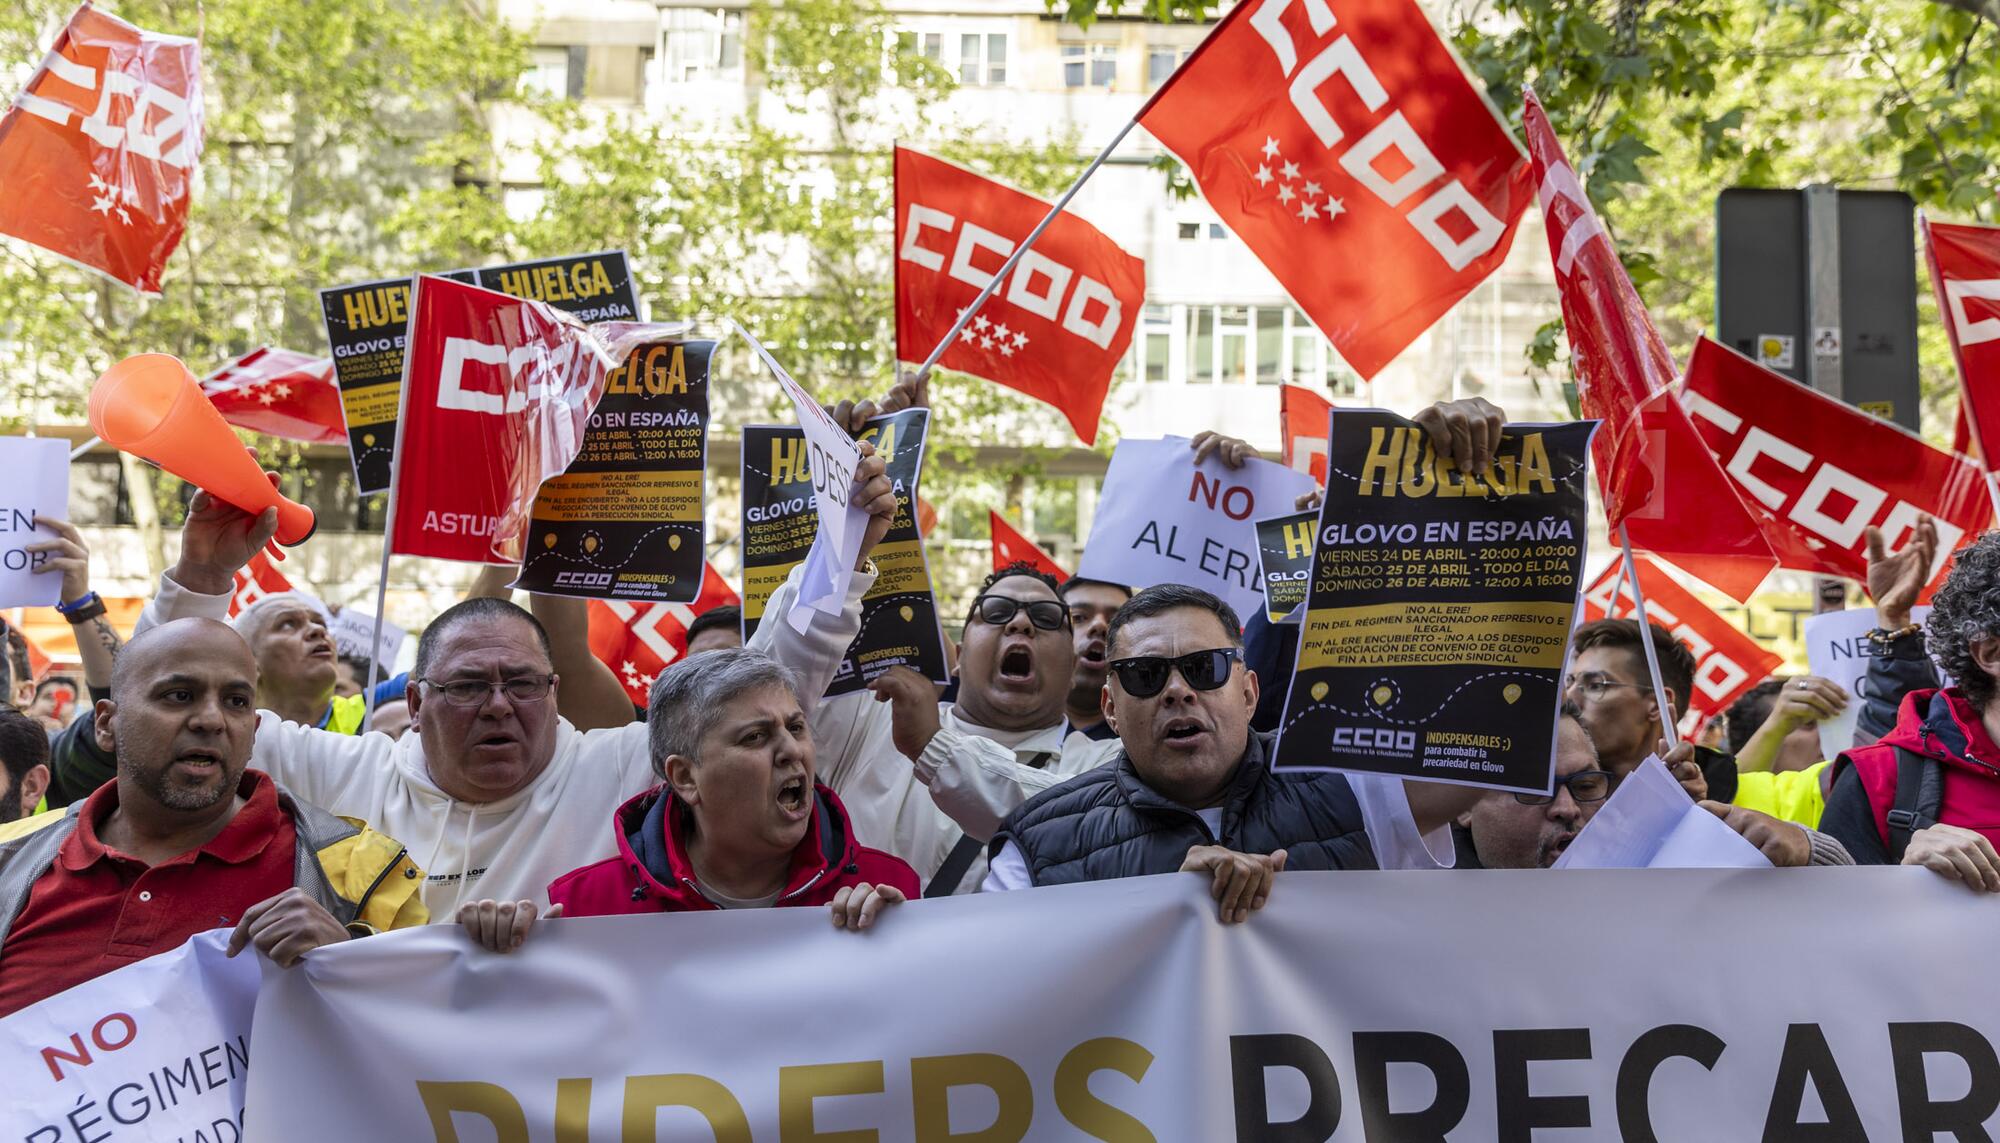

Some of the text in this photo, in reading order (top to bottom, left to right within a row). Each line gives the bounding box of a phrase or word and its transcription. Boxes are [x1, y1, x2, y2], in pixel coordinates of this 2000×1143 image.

[1249, 0, 1506, 272] CCOO
[500, 260, 613, 302] HUELGA
[900, 202, 1122, 351] CCOO
[335, 338, 391, 357] GLOVO
[604, 346, 687, 395] ELGA
[605, 412, 626, 428] EN
[630, 409, 700, 426] ESPAÑA
[596, 432, 608, 441] DE
[609, 431, 631, 440] ABRIL
[638, 430, 663, 438] 20:00
[675, 429, 701, 437] 00:00
[588, 438, 698, 451] 25 DE ABRIL TODO EL DÍA
[590, 449, 700, 461] 26 DE ABRIL 12:00 A 16:00
[601, 481, 651, 489] SANCIONADOR
[653, 480, 693, 488] REPRESIVO
[1188, 470, 1255, 521] NO
[610, 503, 648, 511] CONVENIO
[649, 503, 659, 511] DE
[660, 503, 686, 511] GLOVO
[641, 511, 674, 519] SINDICAL
[747, 497, 804, 522] GLOVO
[747, 519, 785, 535] VIERNES
[797, 516, 807, 525] DE
[1322, 523, 1417, 545] GLOVO
[1424, 521, 1460, 543] EN
[1467, 516, 1574, 542] ESPAÑA
[750, 525, 813, 545] SÁBADO 25 DE
[1131, 520, 1187, 563] AL
[747, 541, 793, 556] DOMINGO
[1319, 545, 1577, 563] VIERNES 24 DE ABRIL 20:00 A 00:00
[1268, 569, 1311, 581] GLO
[1321, 557, 1570, 578] SÁBADO 25 DE ABRIL TODO EL DÍA
[555, 572, 613, 585] CCOO
[1315, 578, 1383, 593] DOMINGO
[1386, 577, 1403, 588] 26
[1406, 577, 1427, 588] DE
[1429, 577, 1472, 588] ABRIL
[1484, 577, 1520, 588] 12:00
[1522, 576, 1533, 587] A
[1536, 574, 1573, 586] 16:00
[1405, 606, 1471, 615] ¡NO AL ERE!
[1310, 614, 1566, 631] FIN DEL RÉGIMEN SANCIONADOR REPRESIVO E
[1414, 625, 1453, 633] ILEGAL
[1305, 641, 1322, 650] FIN
[1341, 636, 1364, 645] ERE
[1364, 634, 1435, 644] ENCUBIERTO
[1466, 634, 1475, 642] A
[1477, 633, 1500, 642] LOS
[1502, 634, 1563, 646] DESPIDOS!
[1321, 643, 1541, 656] NEGOCIACIÓN DE CONVENIO DE GLOVO
[1338, 652, 1519, 664] FIN A LA PERSECUCIÓN SINDICAL
[1332, 727, 1416, 751] CCOO
[1424, 746, 1487, 758] para combatir la
[1422, 758, 1505, 773] precariedad en Glovo
[40, 1012, 137, 1082] NO
[1229, 1022, 2000, 1143] PRECAR
